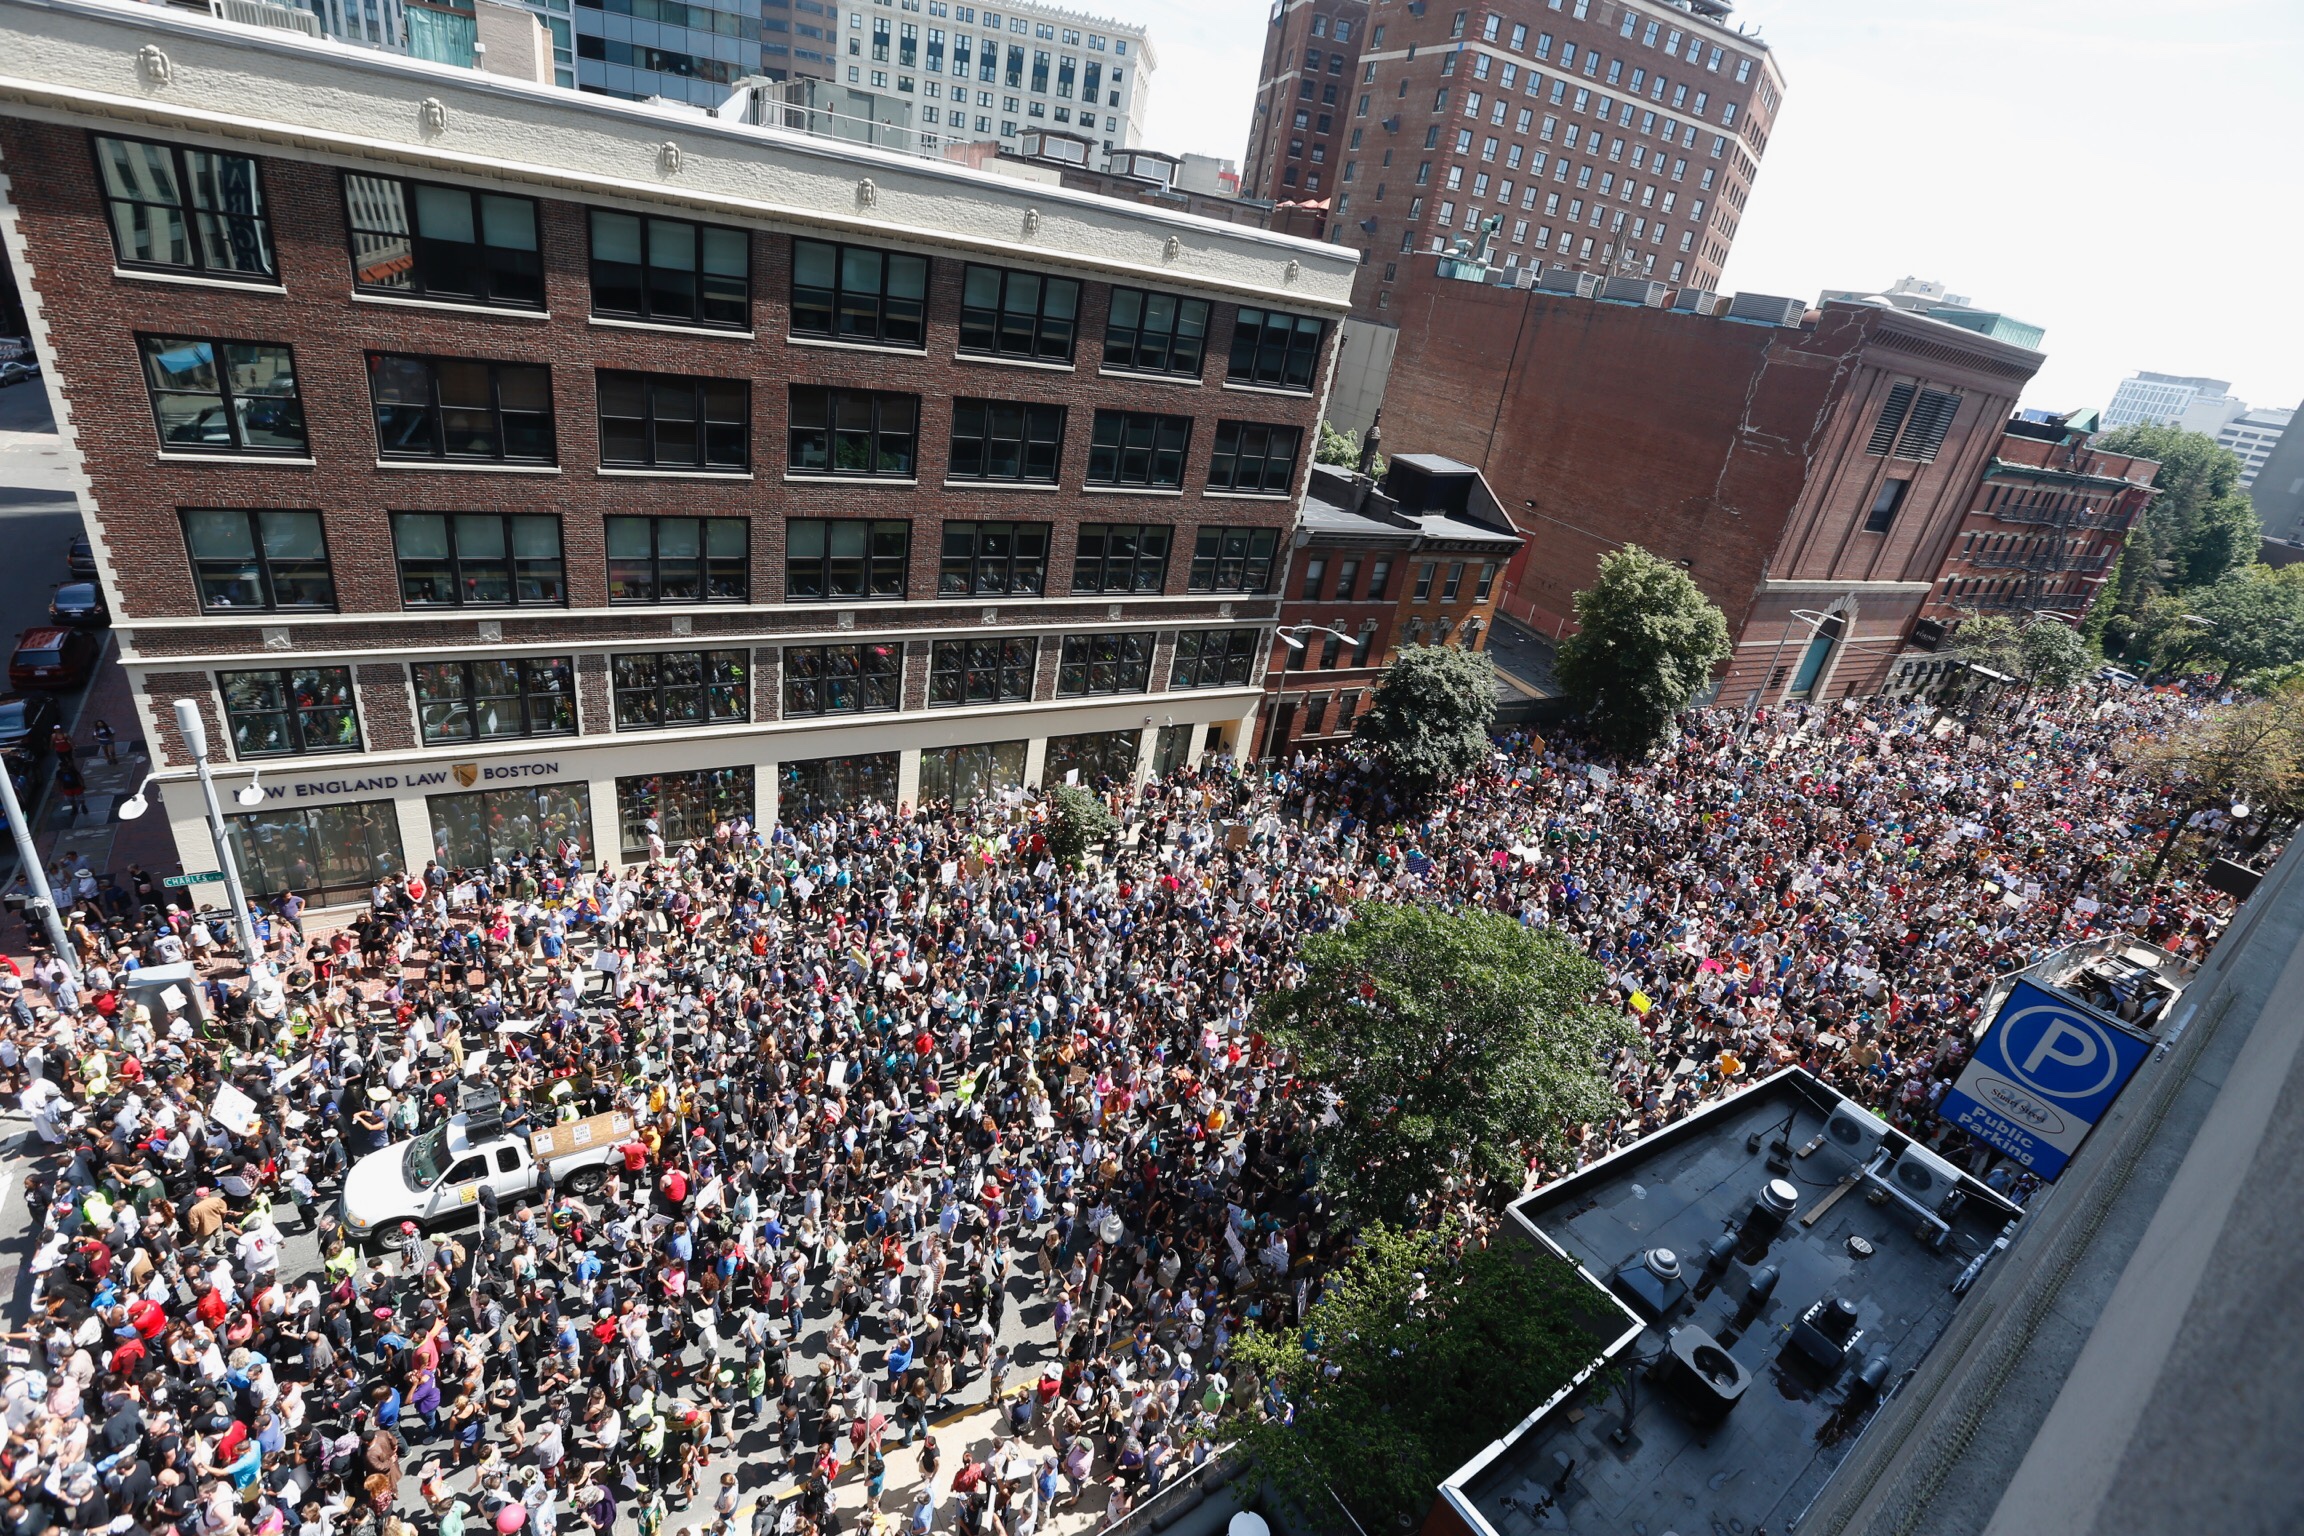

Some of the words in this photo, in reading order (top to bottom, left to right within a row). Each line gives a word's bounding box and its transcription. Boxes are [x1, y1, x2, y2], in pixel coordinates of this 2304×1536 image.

[233, 786, 286, 802] NW
[294, 776, 398, 797] ENGLAND
[405, 772, 447, 787] LAW
[483, 763, 559, 780] BOSTON
[166, 874, 207, 886] CHARLES
[2022, 1017, 2097, 1073] P
[1991, 1089, 2018, 1107] Stuart
[2019, 1105, 2045, 1123] Street
[1958, 1112, 2035, 1166] Parking
[1972, 1106, 2034, 1148] Public
